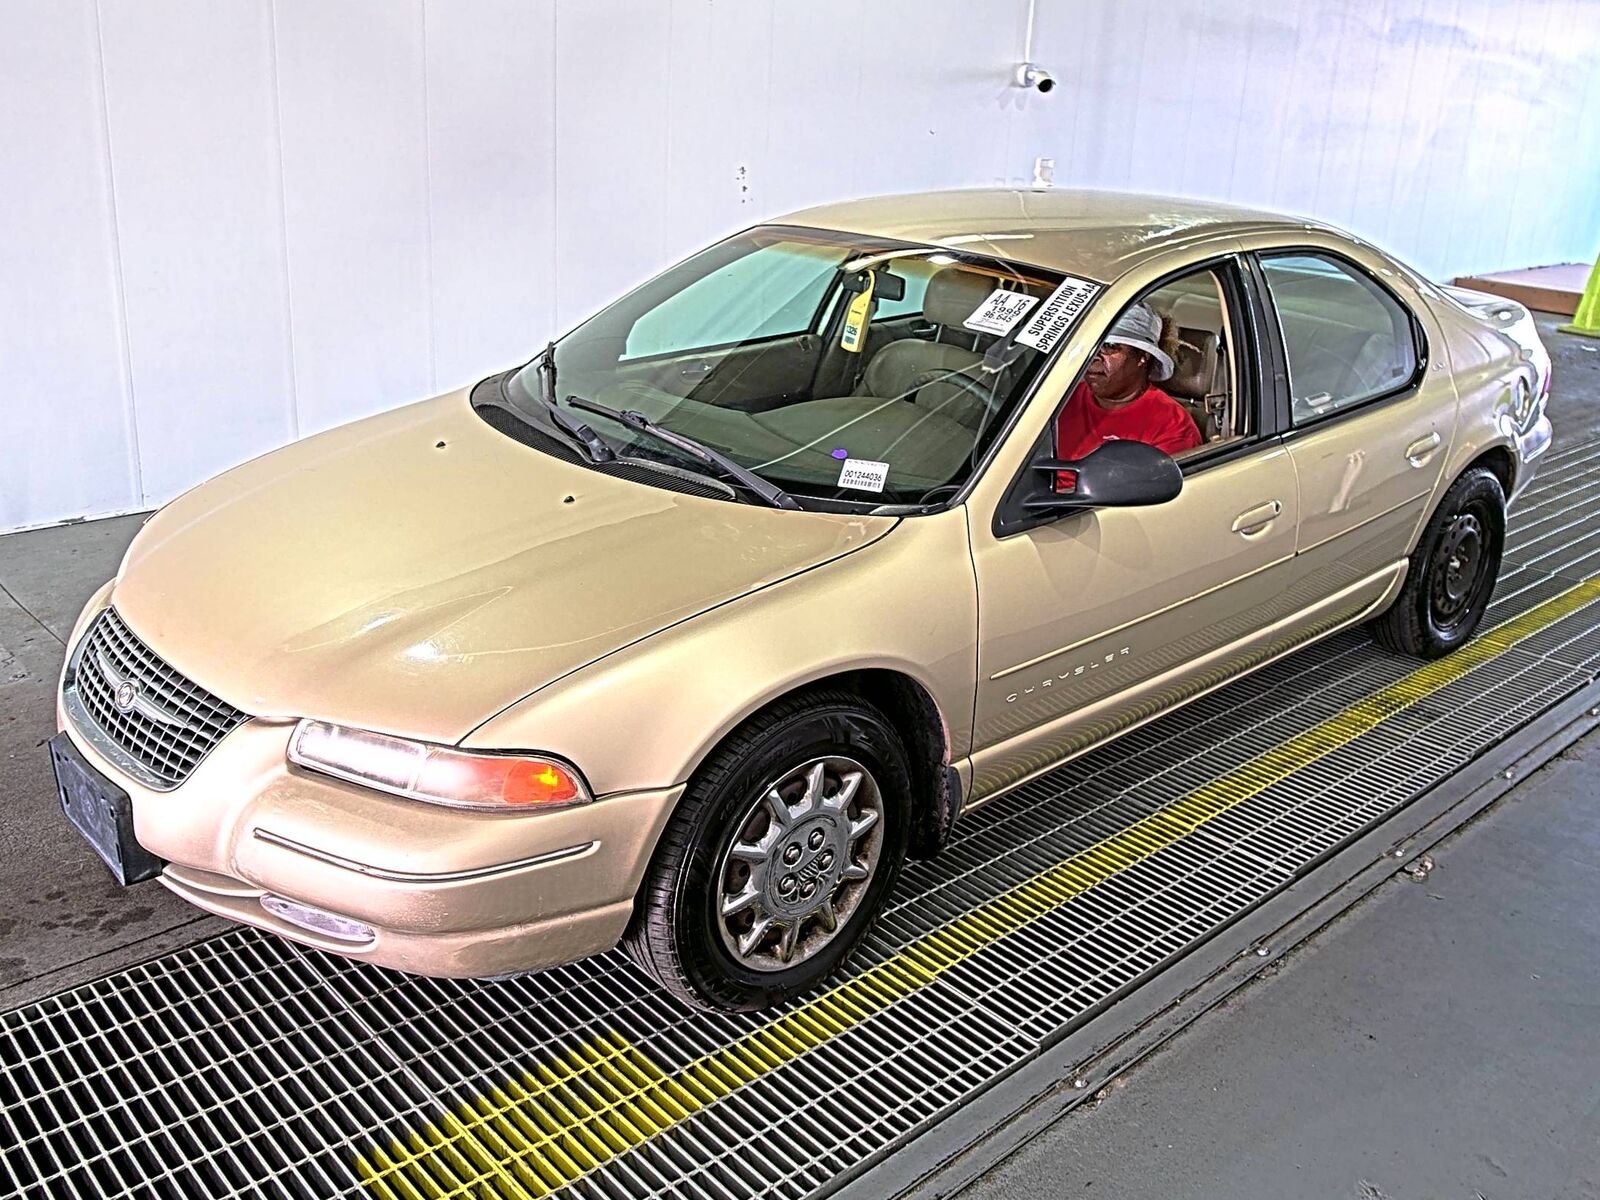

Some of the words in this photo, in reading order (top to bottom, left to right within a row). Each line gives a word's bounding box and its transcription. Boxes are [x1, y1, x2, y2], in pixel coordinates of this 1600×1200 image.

[990, 293, 1011, 306] AA
[1013, 298, 1030, 311] 16
[1028, 285, 1078, 336] SUPERSTITION
[992, 305, 1021, 318] 1999
[1036, 315, 1069, 350] SPRINGS
[1062, 283, 1096, 317] LEXUS-AA
[844, 469, 883, 482] 001244036
